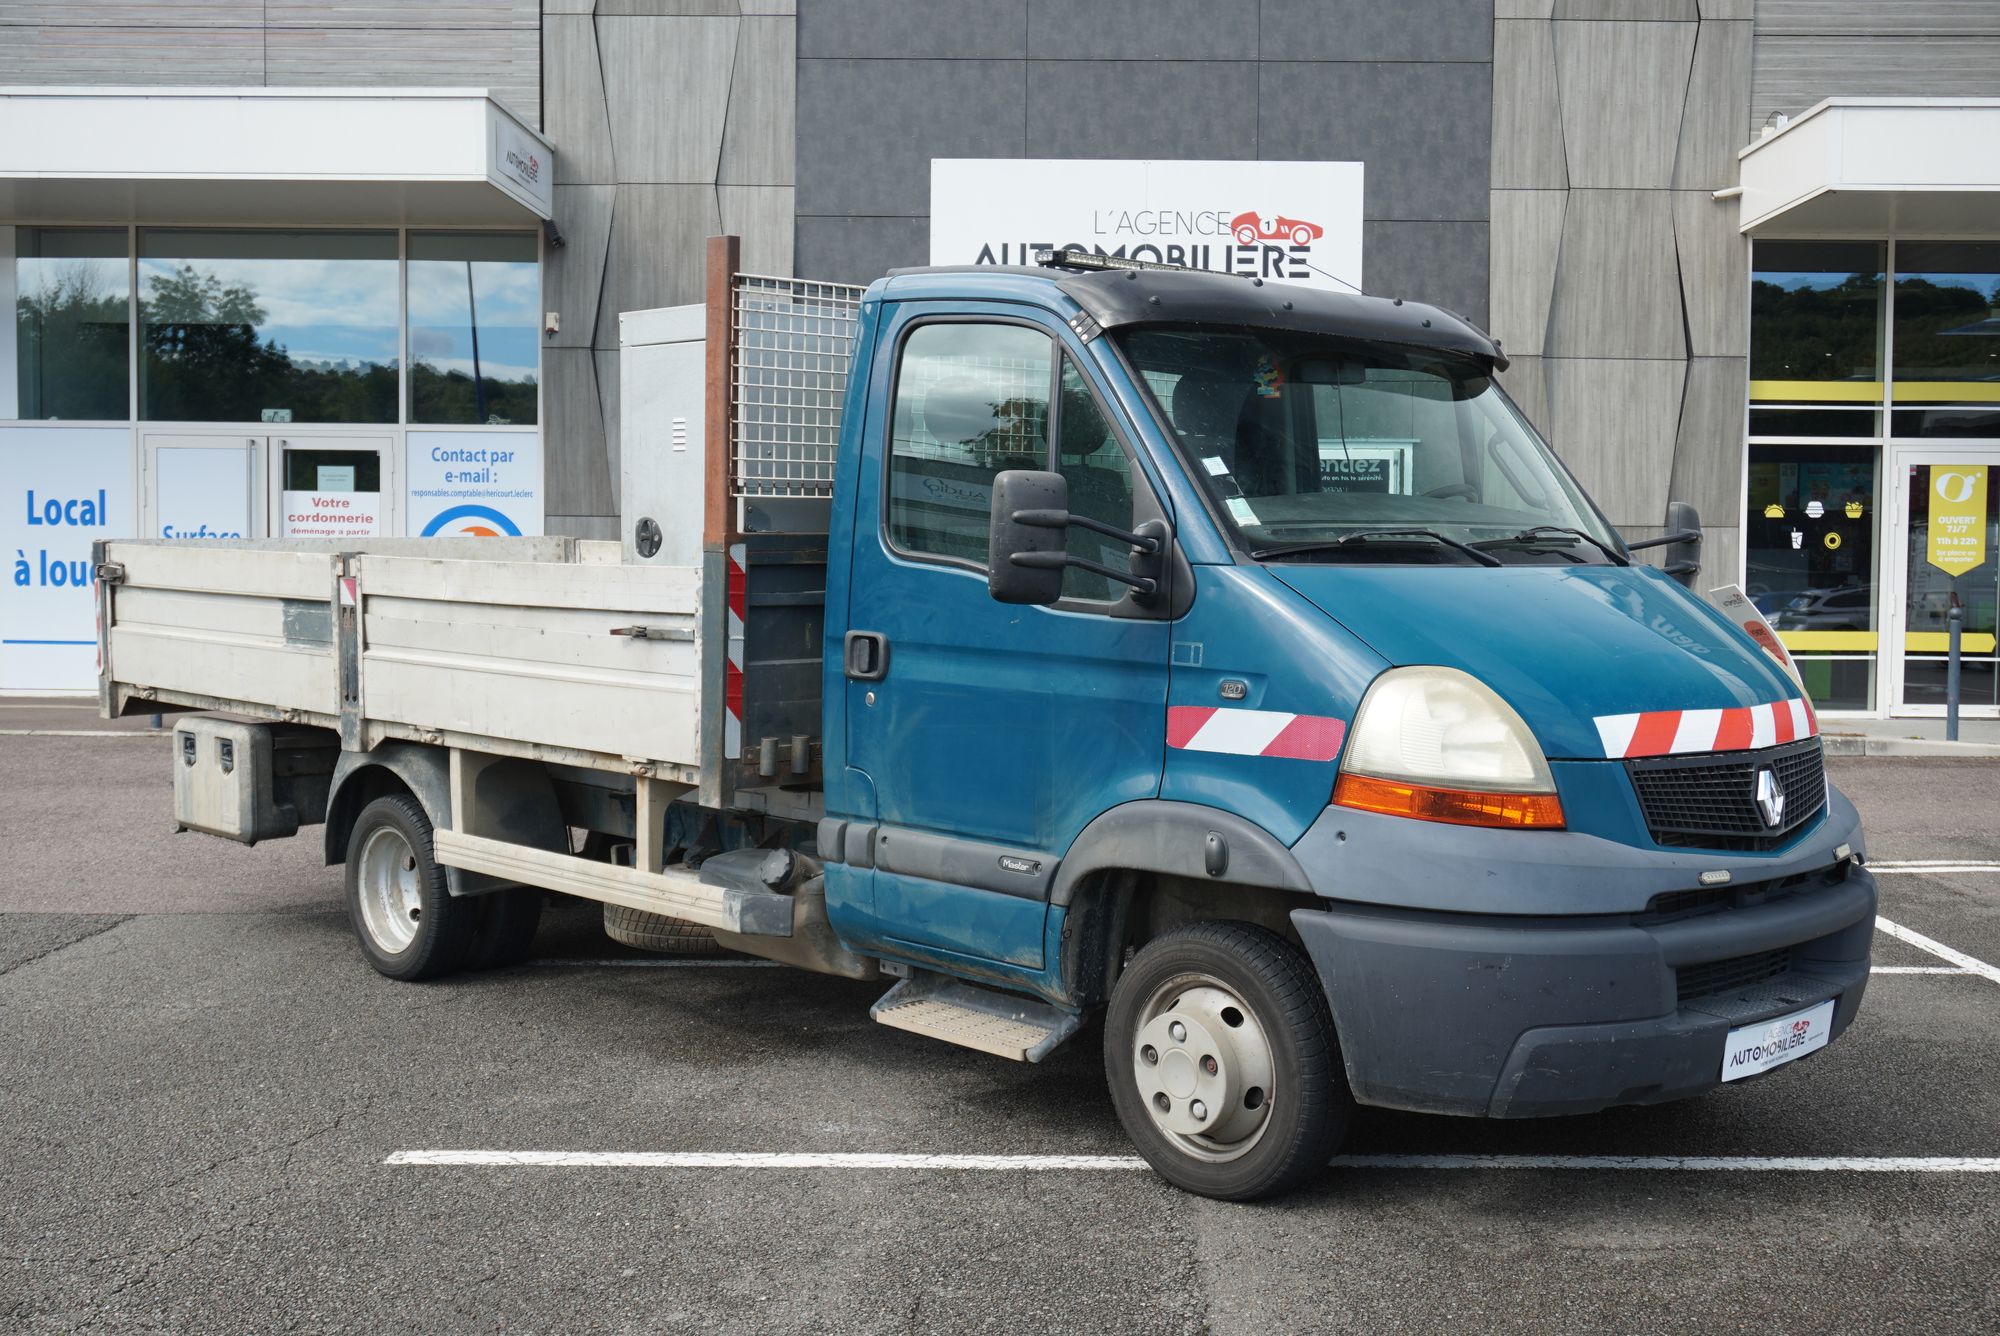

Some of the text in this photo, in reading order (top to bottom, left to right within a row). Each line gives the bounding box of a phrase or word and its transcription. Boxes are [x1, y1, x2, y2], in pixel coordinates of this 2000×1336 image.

[1094, 210, 1231, 235] L'AGENCE
[431, 447, 514, 466] Contact par
[445, 467, 489, 483] e-mail
[27, 489, 106, 525] Local
[312, 497, 350, 508] Votre
[288, 513, 373, 523] cordonnerie
[1938, 516, 1977, 525] OUVERT
[1936, 537, 1951, 545] 11h
[1960, 537, 1977, 545] 22h
[14, 549, 31, 586] à
[1003, 859, 1029, 871] Master
[1730, 1031, 1807, 1067] AUTOMOBILIERE
